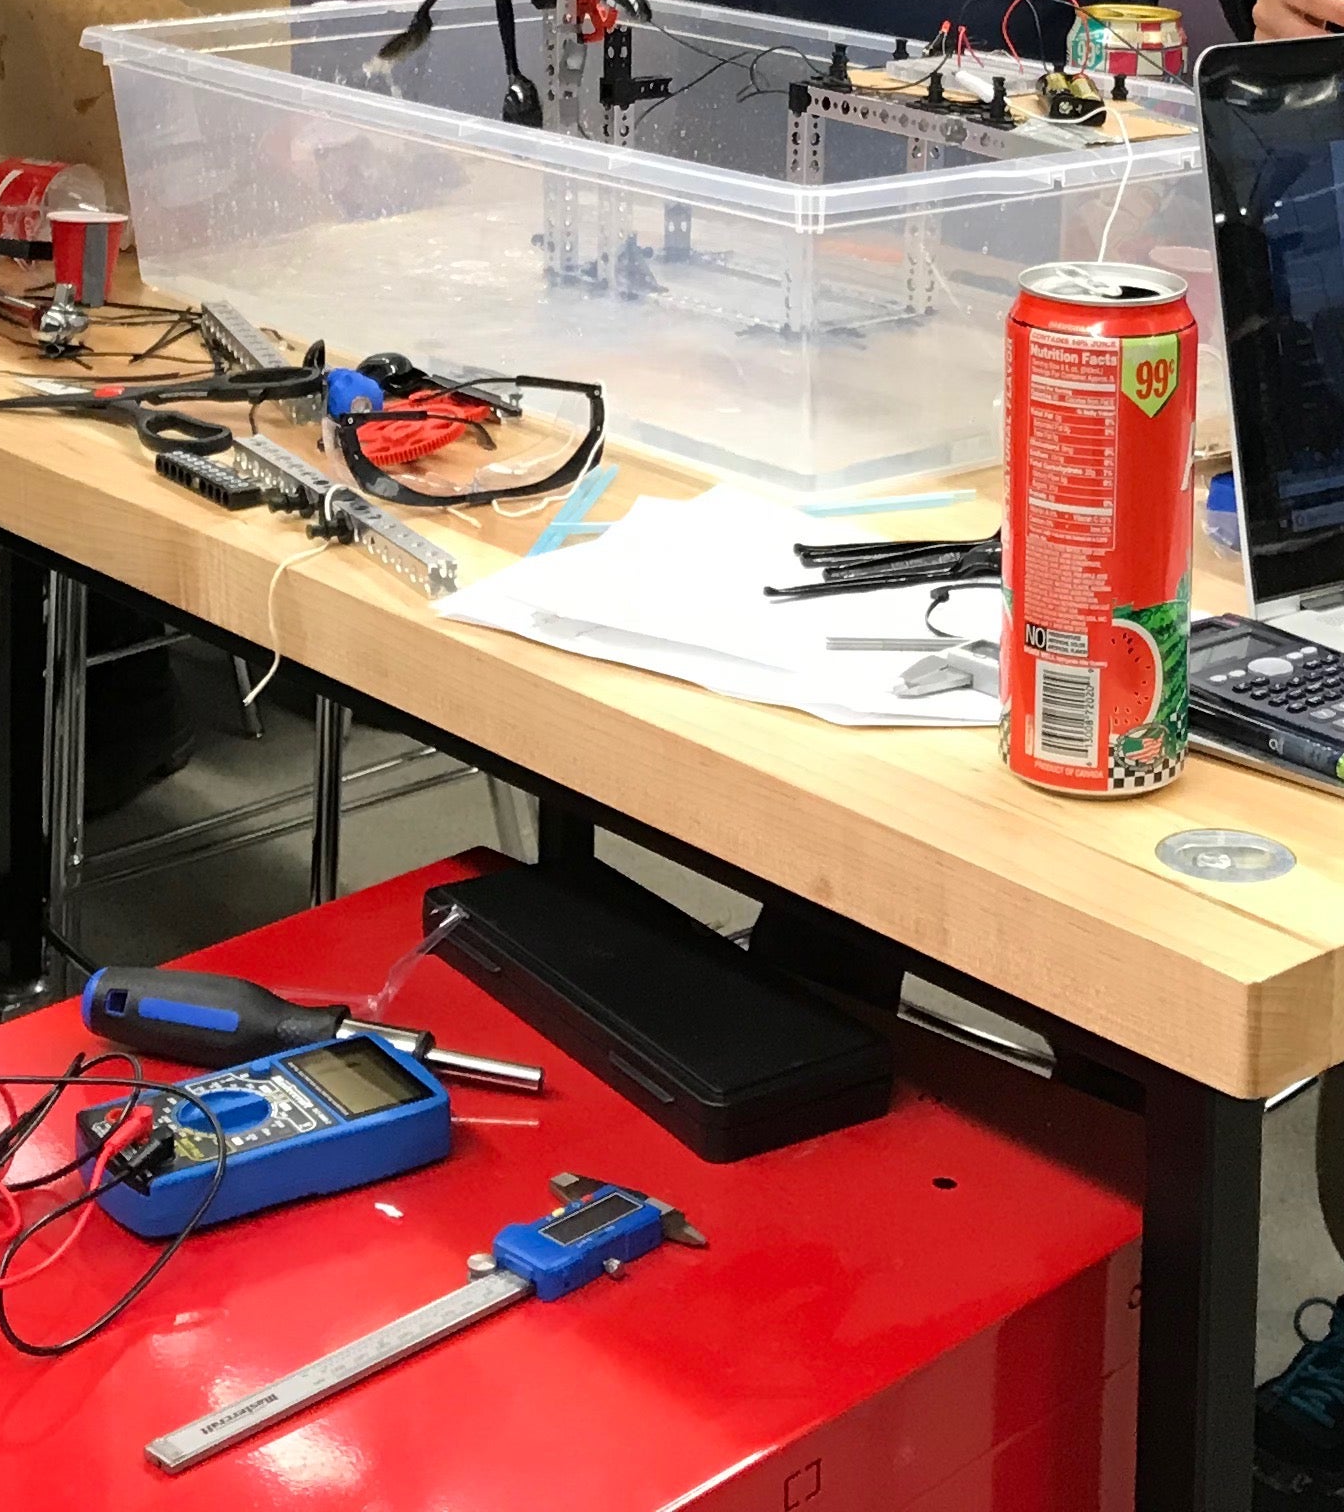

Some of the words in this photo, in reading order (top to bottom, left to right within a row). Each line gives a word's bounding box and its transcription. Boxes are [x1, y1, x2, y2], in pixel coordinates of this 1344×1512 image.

[1030, 342, 1079, 363] Nutrition
[1081, 350, 1118, 366] Facts
[1135, 358, 1175, 400] 99¢
[1025, 623, 1046, 649] NO
[201, 1392, 278, 1436] Mastercraft
